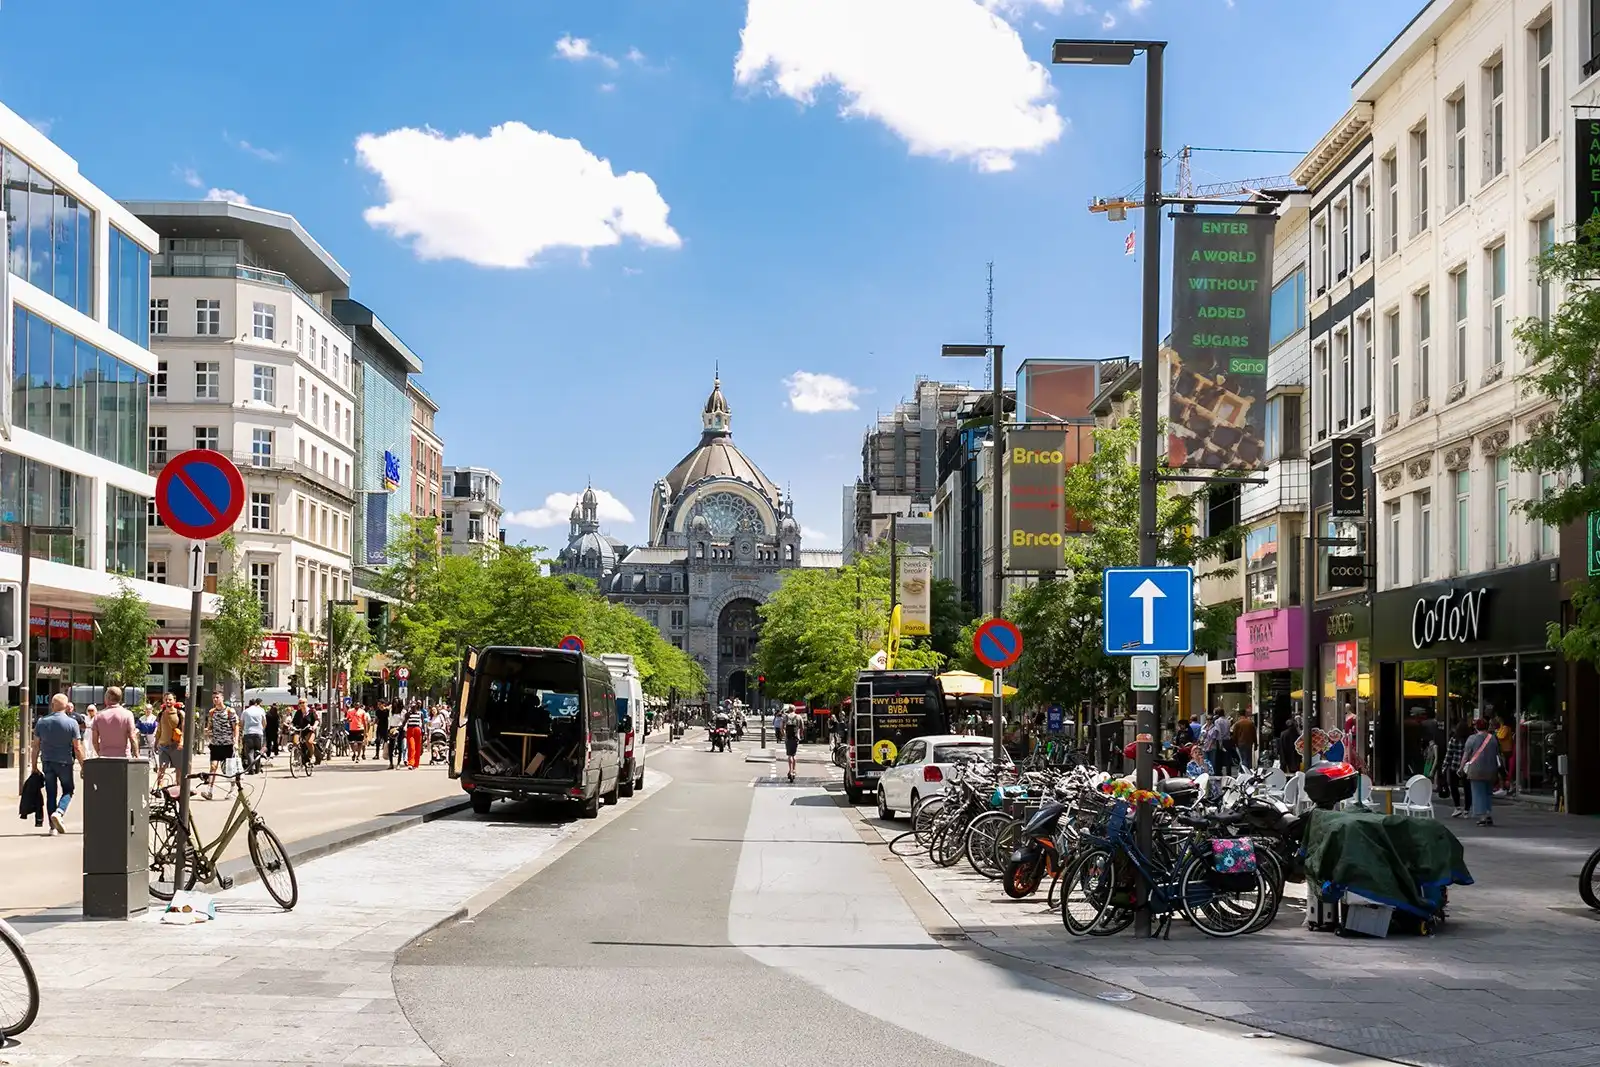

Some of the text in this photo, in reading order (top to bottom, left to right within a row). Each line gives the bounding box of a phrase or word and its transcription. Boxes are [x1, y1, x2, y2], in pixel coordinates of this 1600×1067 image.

[1203, 222, 1248, 235] ENTER
[1192, 250, 1256, 263] A WORLD
[1189, 278, 1258, 291] WITHOUT
[1198, 306, 1246, 319] ADDED
[1193, 334, 1249, 348] SUGARS
[1232, 360, 1264, 373] Sano
[1013, 447, 1064, 464] Brico
[1340, 443, 1356, 500] COCO
[1012, 529, 1063, 547] Brico
[1331, 566, 1363, 578] COCO
[1141, 670, 1151, 678] 13
[872, 697, 889, 705] RWY
[888, 705, 908, 714] BVBA
